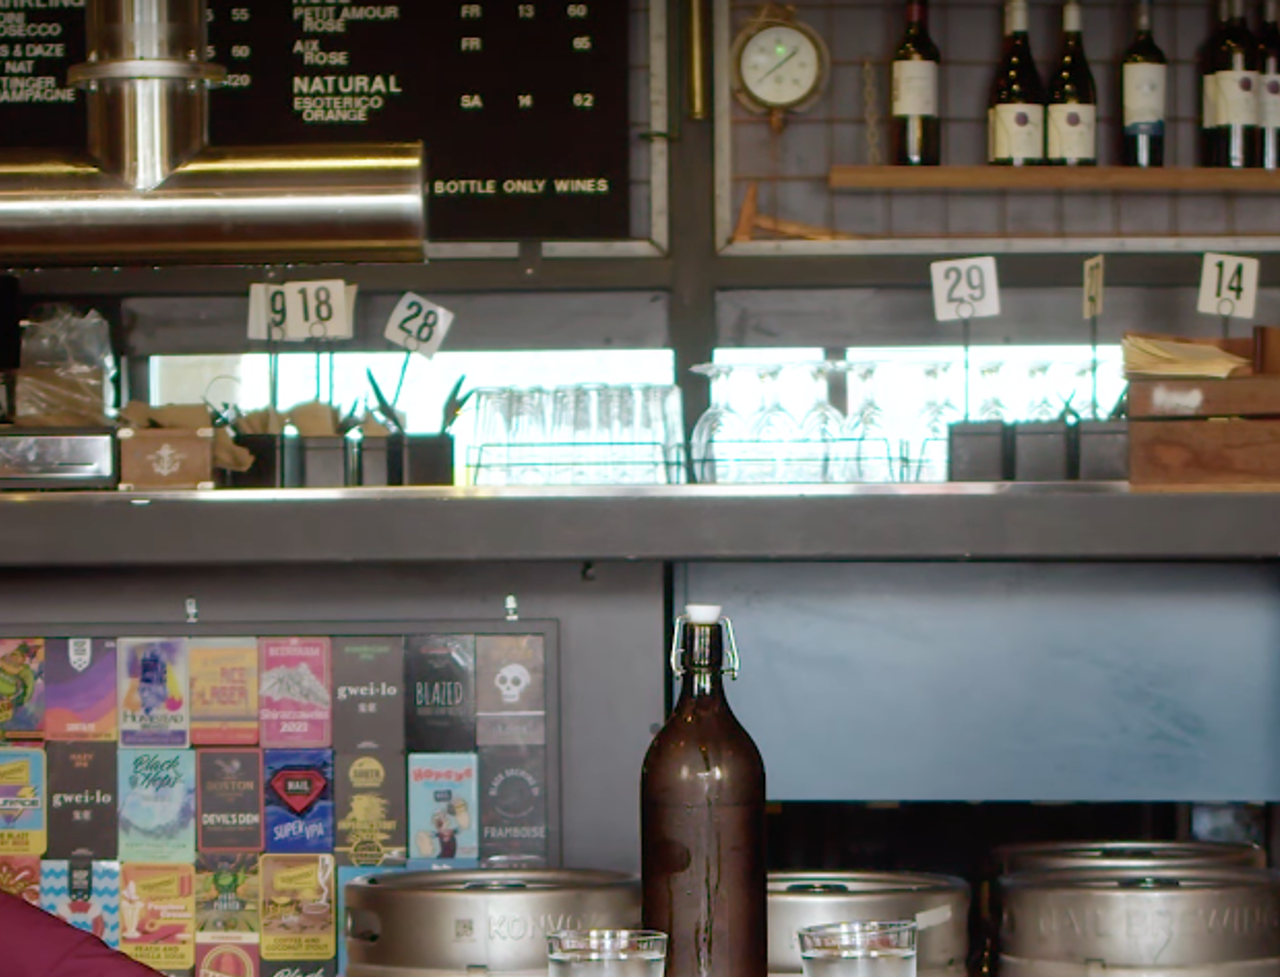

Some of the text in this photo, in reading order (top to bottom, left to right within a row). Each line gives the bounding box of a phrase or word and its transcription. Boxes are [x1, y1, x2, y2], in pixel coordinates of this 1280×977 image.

[231, 8, 250, 21] 55
[293, 7, 336, 20] PETIT
[340, 6, 399, 19] AMOUR
[461, 4, 481, 18] FR
[518, 5, 535, 18] 13
[303, 19, 346, 32] ROSE
[12, 45, 23, 57] &
[25, 43, 65, 57] DAZE
[293, 39, 320, 53] AIX
[461, 37, 481, 50] FR
[304, 52, 349, 65] ROSE
[5, 60, 35, 73] NAT
[293, 75, 403, 93] NATURAL
[294, 96, 384, 110] ESOTERICO
[461, 95, 483, 108] SA
[303, 109, 368, 121] ORANGE
[434, 179, 609, 193] BOTTLE ONLY WINES
[943, 264, 986, 304] 29
[1216, 260, 1244, 301] 14
[297, 286, 333, 322] 18
[397, 300, 438, 343] 28
[415, 681, 464, 706] BLAZED
[280, 721, 308, 733] 2021
